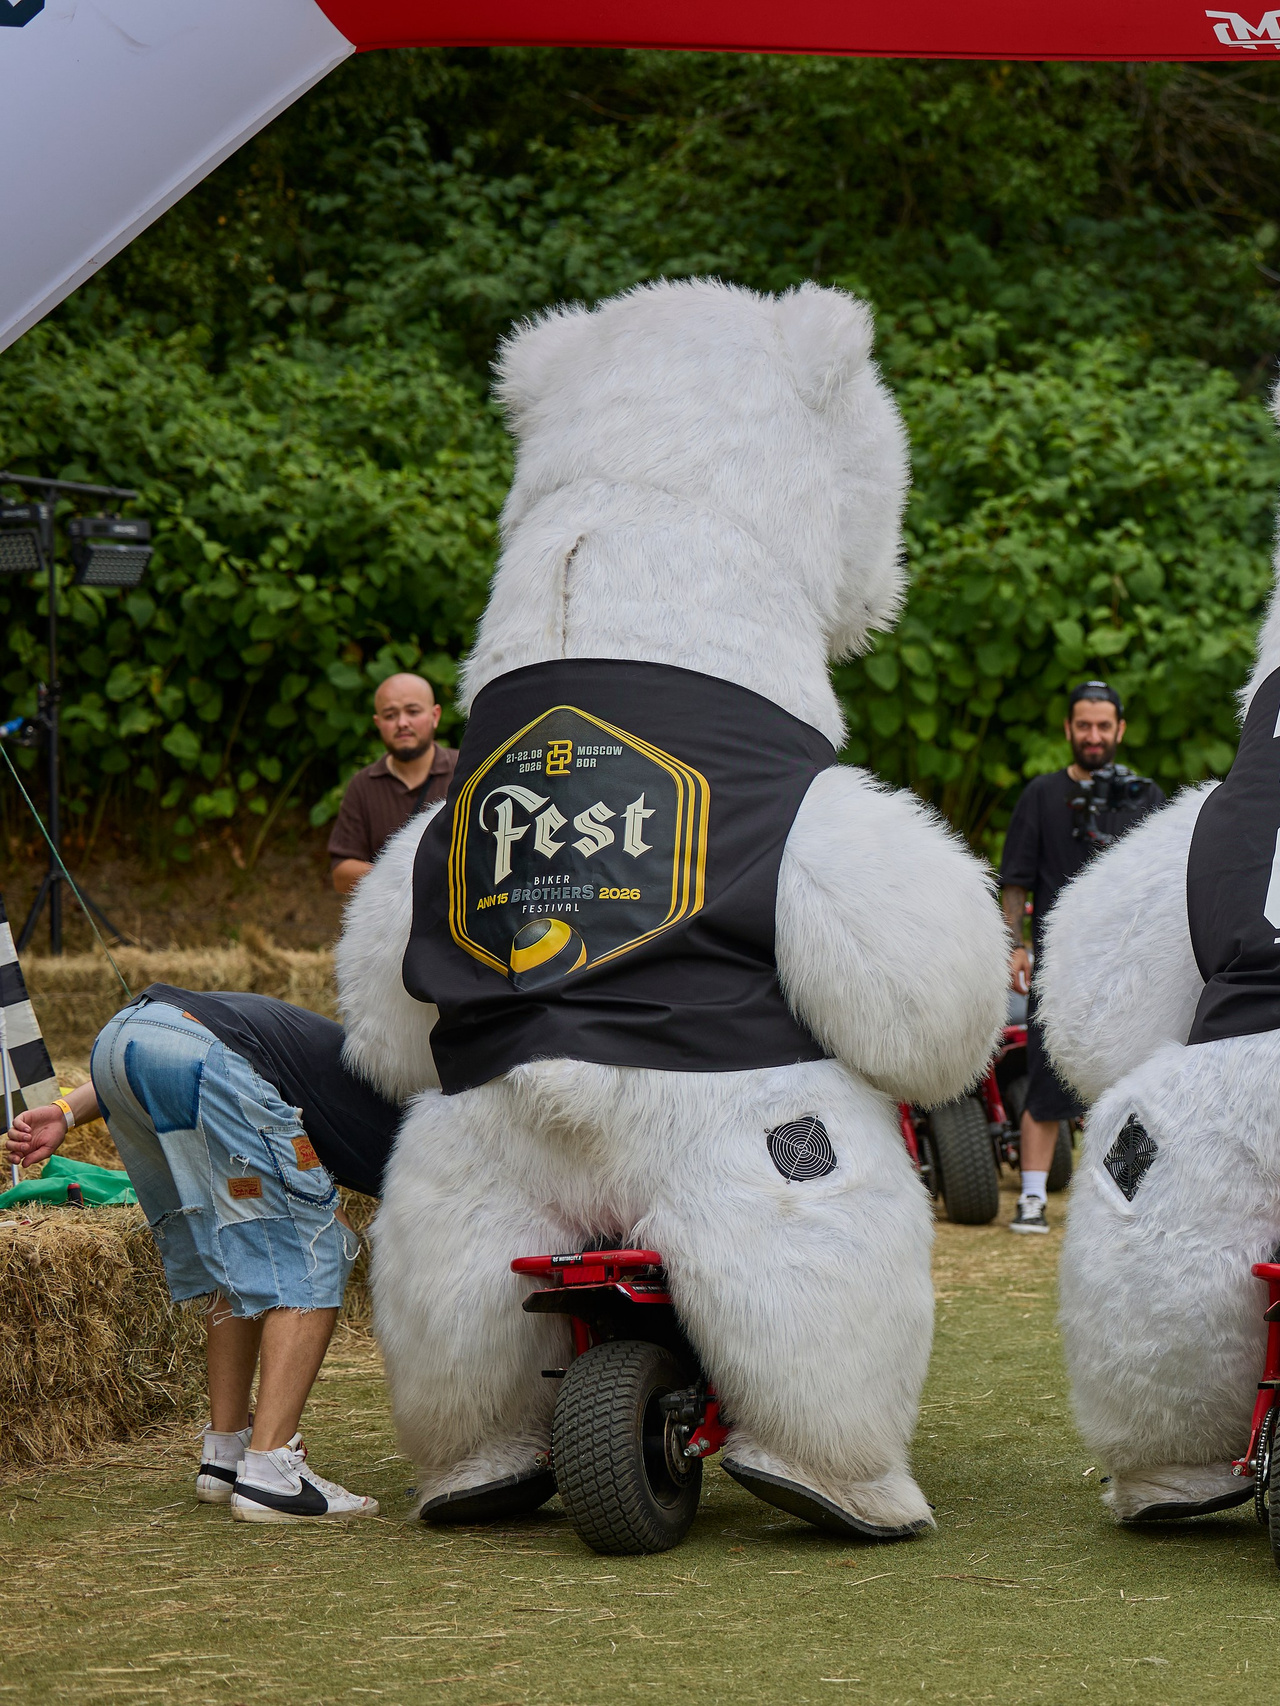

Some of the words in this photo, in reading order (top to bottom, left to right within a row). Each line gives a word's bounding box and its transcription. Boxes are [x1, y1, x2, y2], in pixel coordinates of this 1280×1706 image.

[506, 749, 542, 764] 21-22.08
[577, 746, 623, 756] MOSCOW
[519, 761, 542, 774] 2026
[576, 758, 597, 768] BOR
[479, 784, 656, 885] Fest
[534, 874, 570, 886] BIKER
[511, 885, 595, 903] BROTHERS
[598, 887, 641, 900] 2026
[522, 903, 580, 914] FESTIVAL
